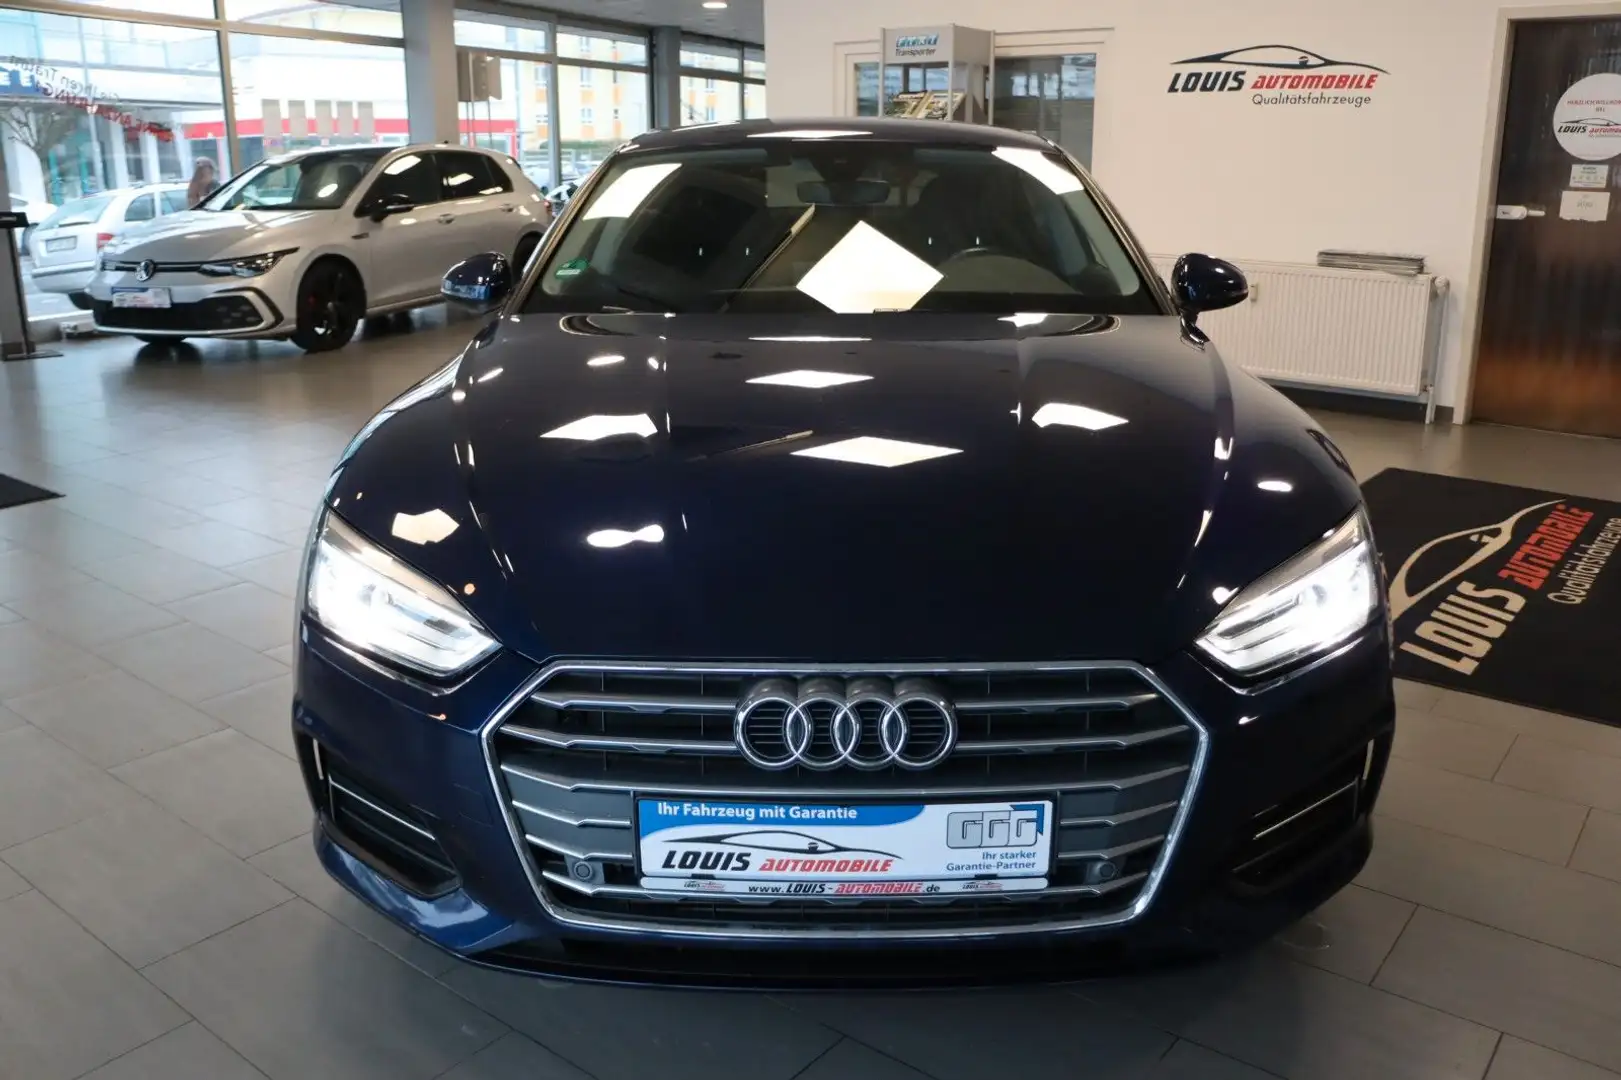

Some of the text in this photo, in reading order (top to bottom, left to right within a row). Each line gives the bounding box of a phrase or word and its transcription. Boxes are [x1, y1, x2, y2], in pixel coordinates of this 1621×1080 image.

[1167, 71, 1379, 93] LOUIS AUTOMOBILE
[1252, 92, 1372, 108] Qualitätsfahrzeuge
[1557, 125, 1588, 133] LOUIS
[1400, 504, 1594, 676] LOUIS AUTOMOBILE
[657, 802, 858, 821] Ihr Fahrzeug mit Garantie
[662, 850, 894, 873] LOUIS AUTOMOBILE
[982, 850, 1037, 861] Ihr starker
[946, 860, 1037, 872] Garantie-Partner
